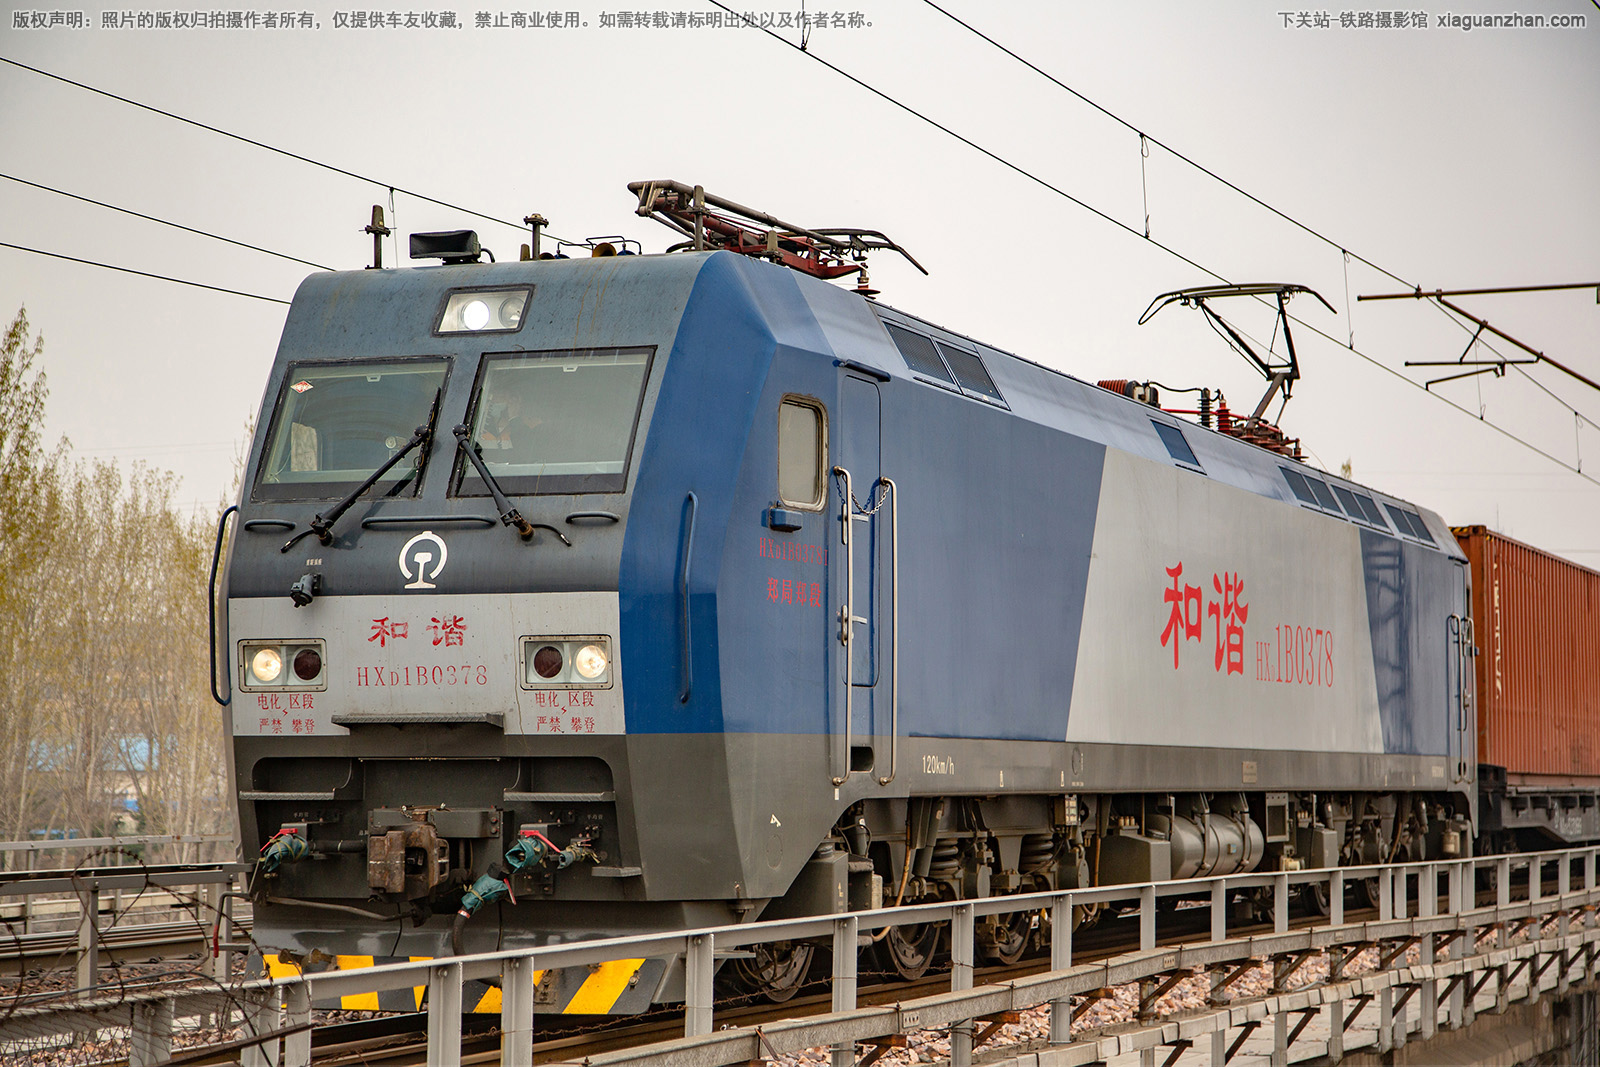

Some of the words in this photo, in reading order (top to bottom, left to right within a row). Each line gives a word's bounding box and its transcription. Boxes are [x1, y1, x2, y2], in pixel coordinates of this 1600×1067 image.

[766, 577, 822, 608] 郑局郑段
[367, 614, 468, 648] 和谐
[1160, 561, 1250, 677] 和谐
[357, 664, 489, 687] HXD1B0378
[922, 754, 955, 775] 120km/h
